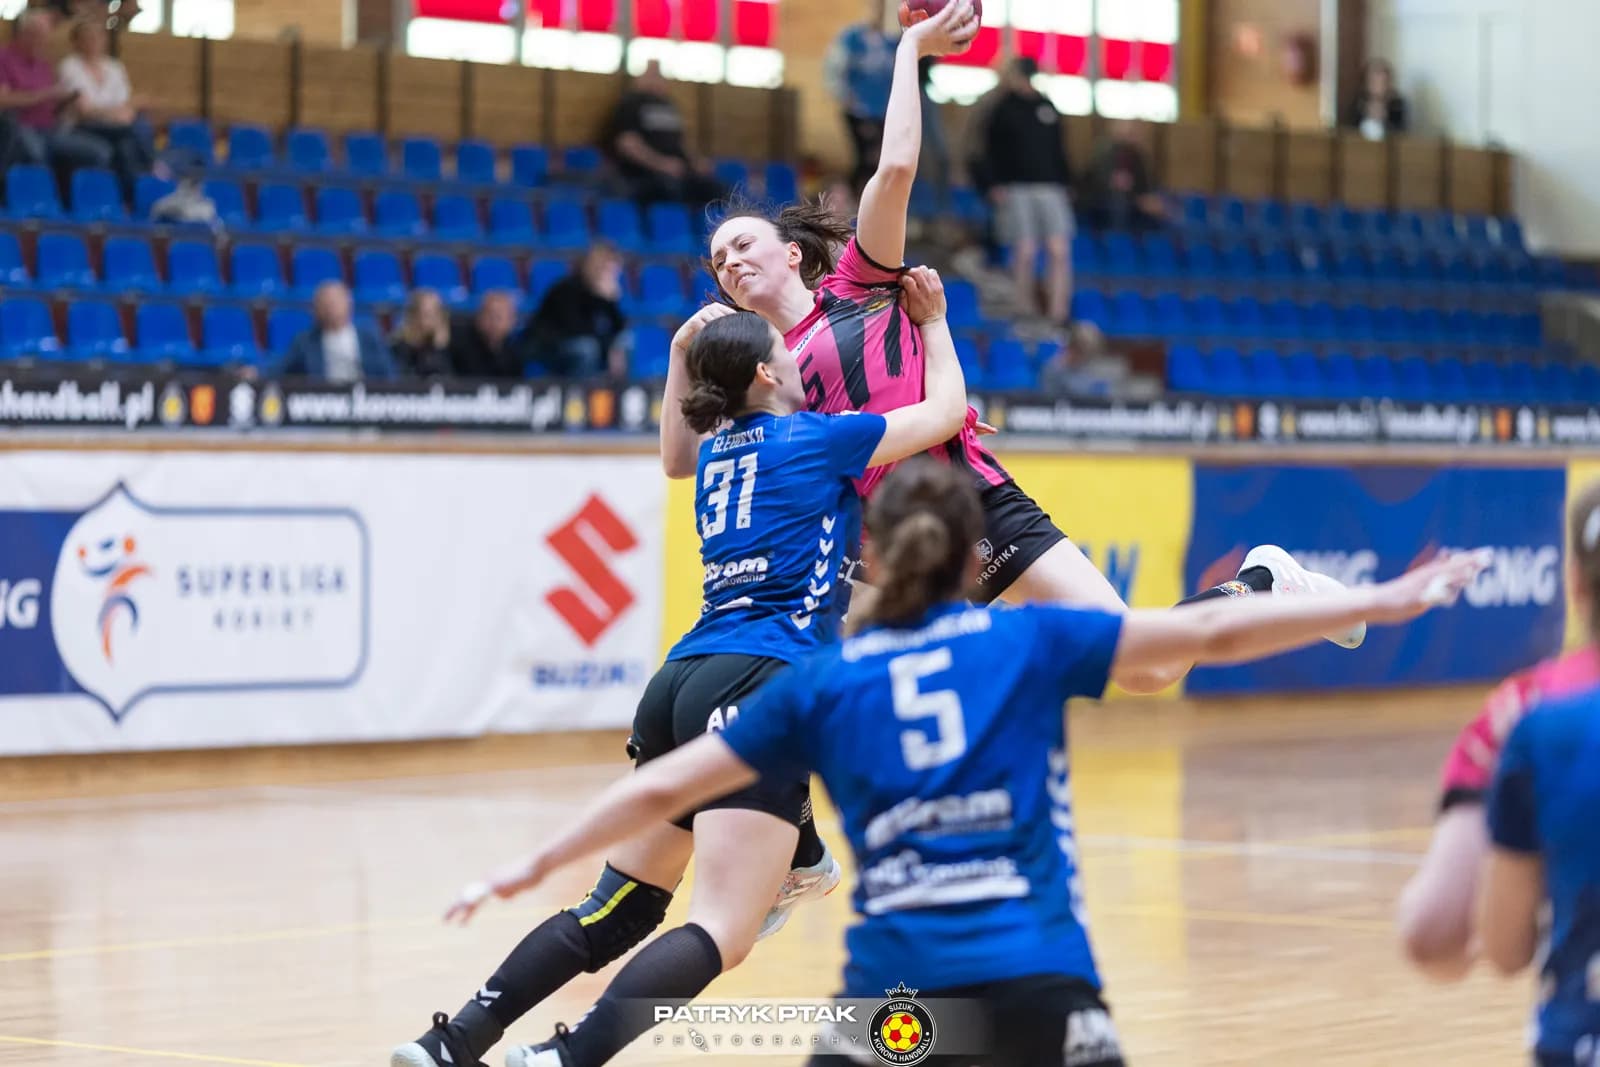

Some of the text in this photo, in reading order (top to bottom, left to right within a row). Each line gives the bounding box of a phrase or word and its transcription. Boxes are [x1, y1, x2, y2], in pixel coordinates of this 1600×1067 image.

[0, 379, 154, 430] handball.pl
[702, 452, 758, 539] 31
[177, 563, 345, 597] SUPERLIGA
[976, 544, 1019, 585] PROFIKA
[889, 649, 966, 771] 5
